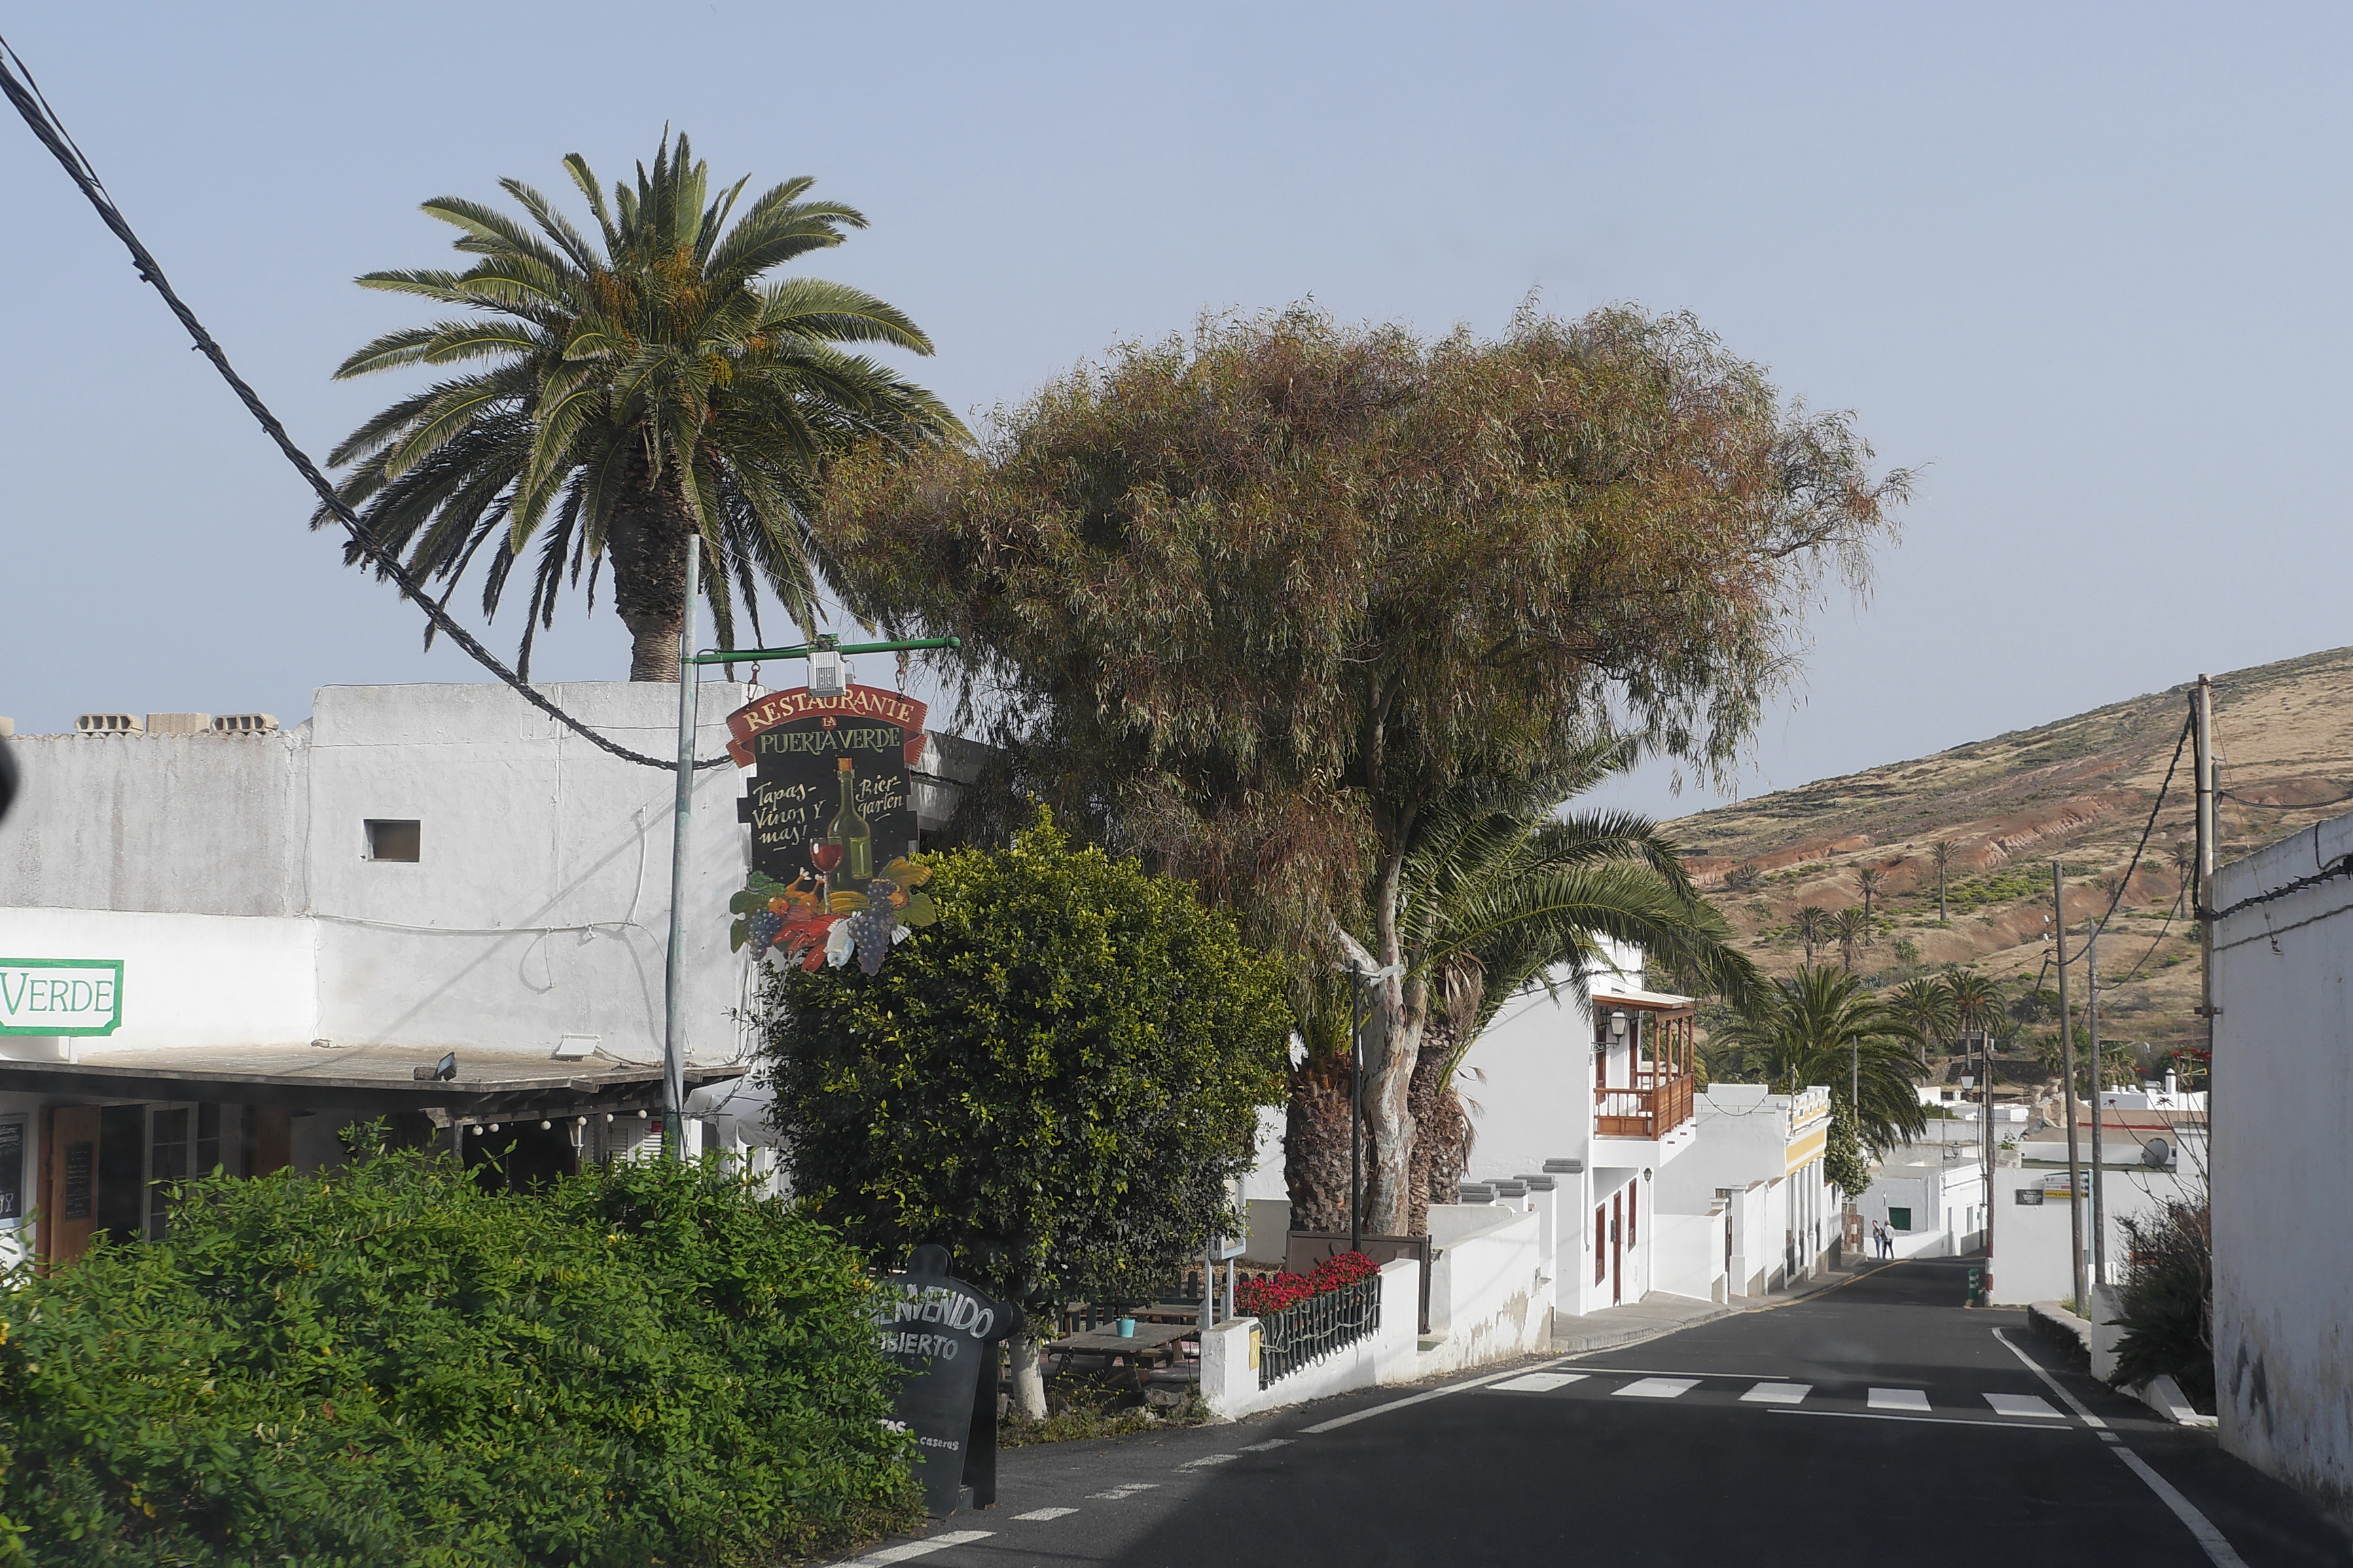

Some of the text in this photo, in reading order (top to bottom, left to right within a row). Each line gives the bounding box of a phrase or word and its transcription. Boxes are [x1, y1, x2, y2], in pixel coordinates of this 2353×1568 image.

[742, 689, 914, 732] RESTAURANTE
[822, 717, 837, 727] LA
[760, 727, 900, 755] PUERTA VERDE
[753, 782, 816, 812] Tapas-
[855, 775, 901, 802] Bier-
[752, 807, 806, 829] Vinos
[857, 791, 904, 820] garten
[758, 825, 808, 845] mas!
[0, 972, 113, 1016] VERDE
[919, 1436, 960, 1451] caseras
